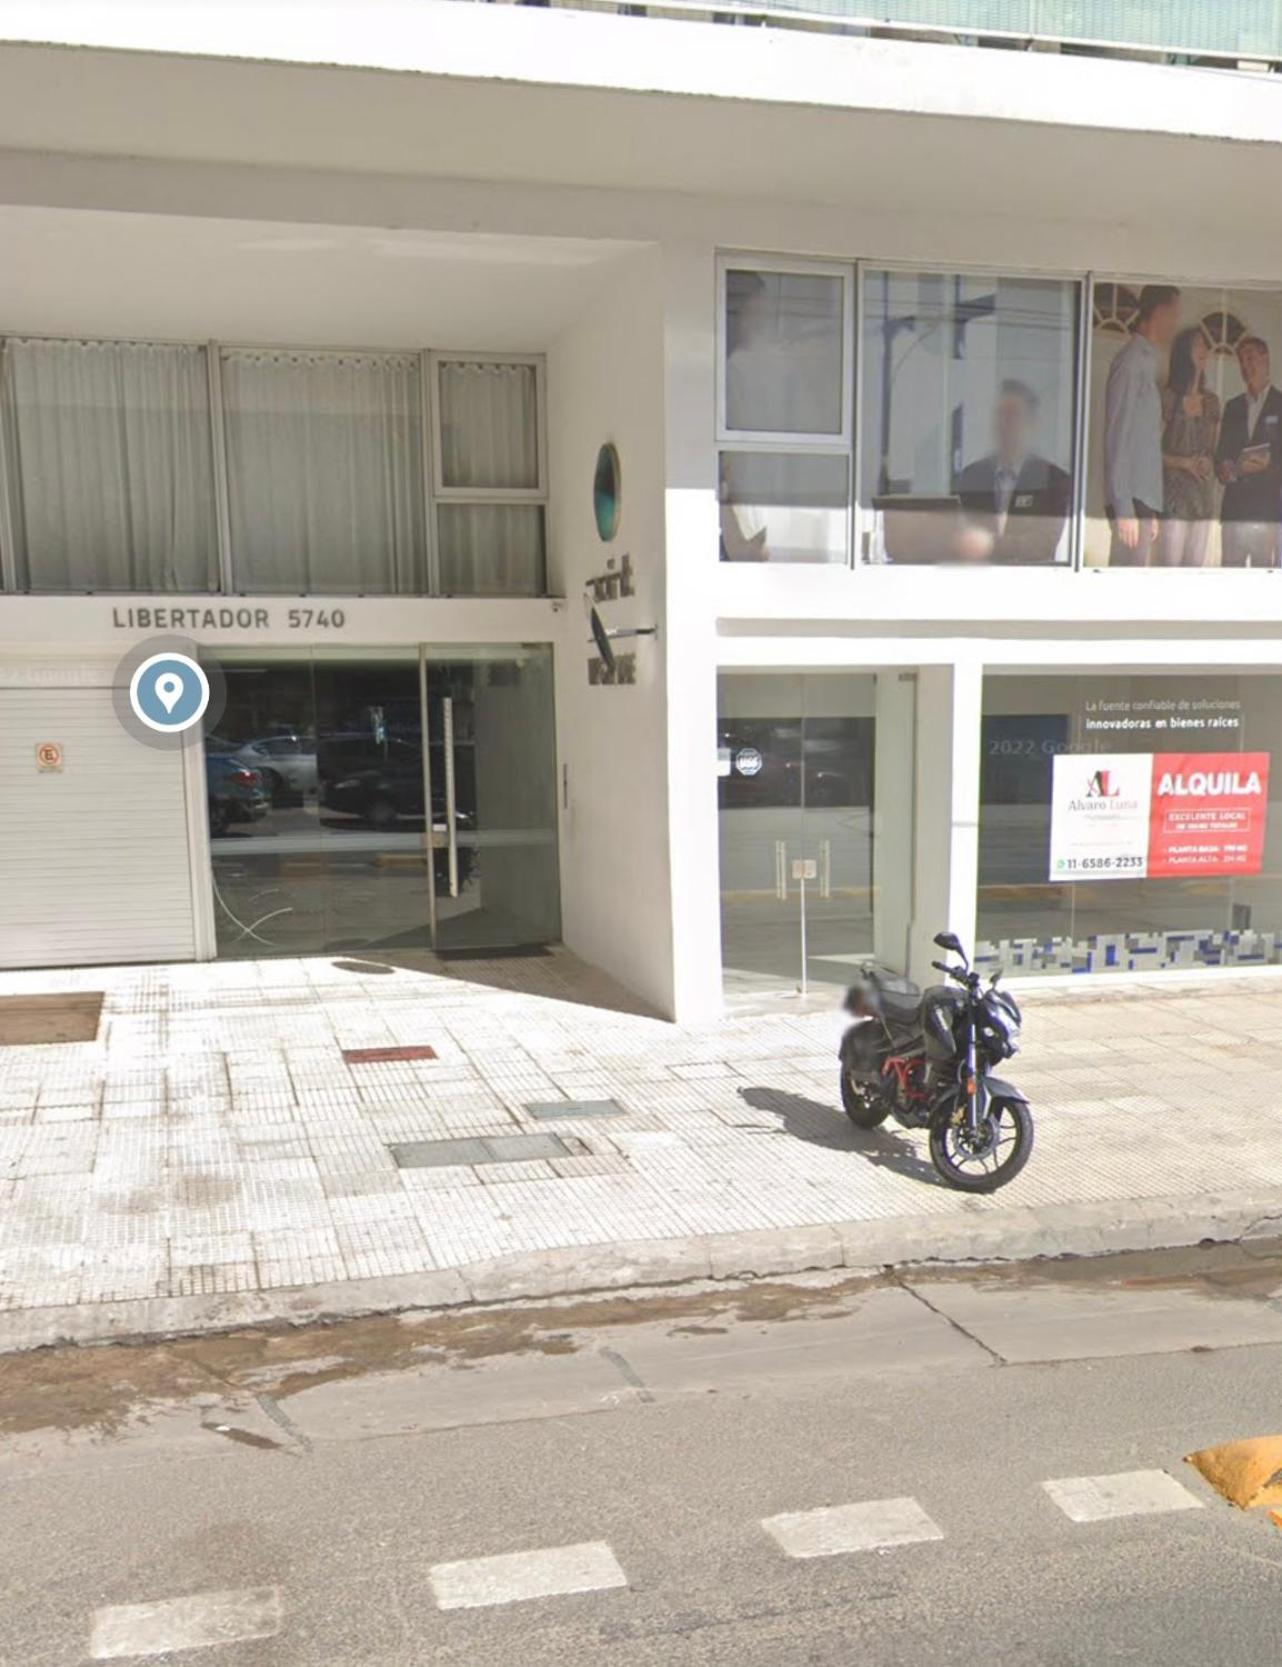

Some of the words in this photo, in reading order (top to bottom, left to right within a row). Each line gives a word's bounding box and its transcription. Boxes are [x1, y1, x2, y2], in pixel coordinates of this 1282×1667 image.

[112, 608, 270, 629] LIBERTADOR
[287, 609, 346, 629] 5740
[1085, 701, 1098, 712] La
[1099, 699, 1131, 712] fuente
[1132, 698, 1176, 711] confiable
[1178, 698, 1190, 711] de
[1192, 698, 1241, 711] soluciones
[1085, 717, 1152, 730] innovadoras
[1169, 716, 1206, 729] bienes
[1207, 715, 1240, 728] raíces
[1157, 771, 1262, 797] ALQUILA
[1068, 799, 1107, 812] Alvaro
[1067, 855, 1144, 870] 11-6586-2233
